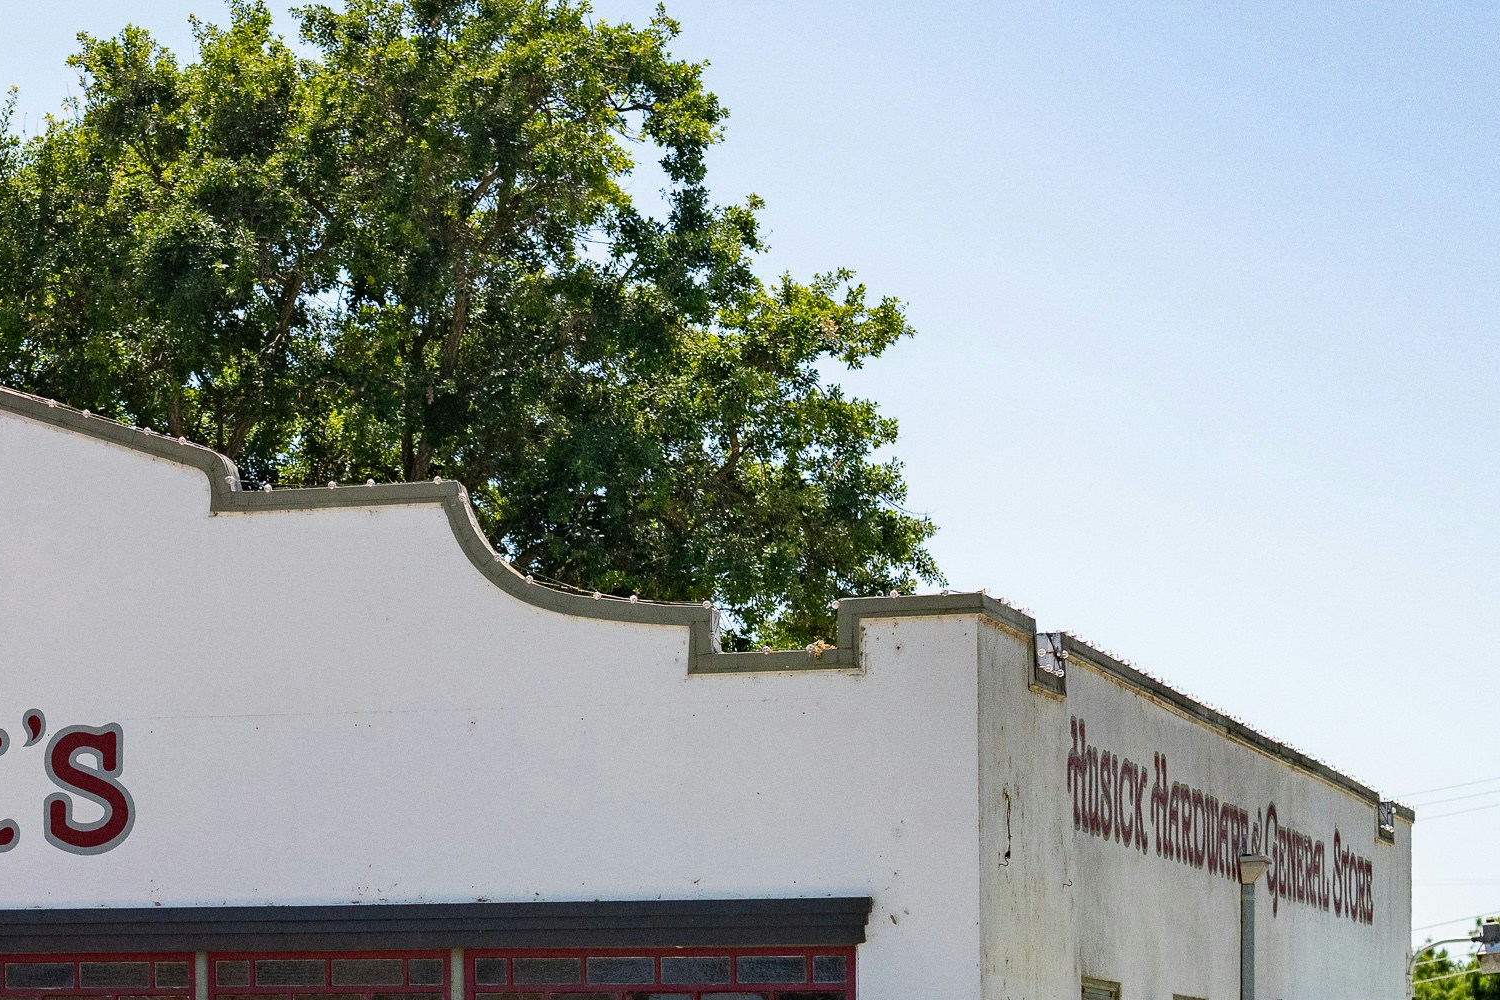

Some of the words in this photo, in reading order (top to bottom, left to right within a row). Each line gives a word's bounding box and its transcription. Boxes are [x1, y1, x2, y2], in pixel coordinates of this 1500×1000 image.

[1067, 715, 1148, 855] HUSICK
[1265, 801, 1330, 918] GENERAL
[1332, 826, 1373, 926] STORE
